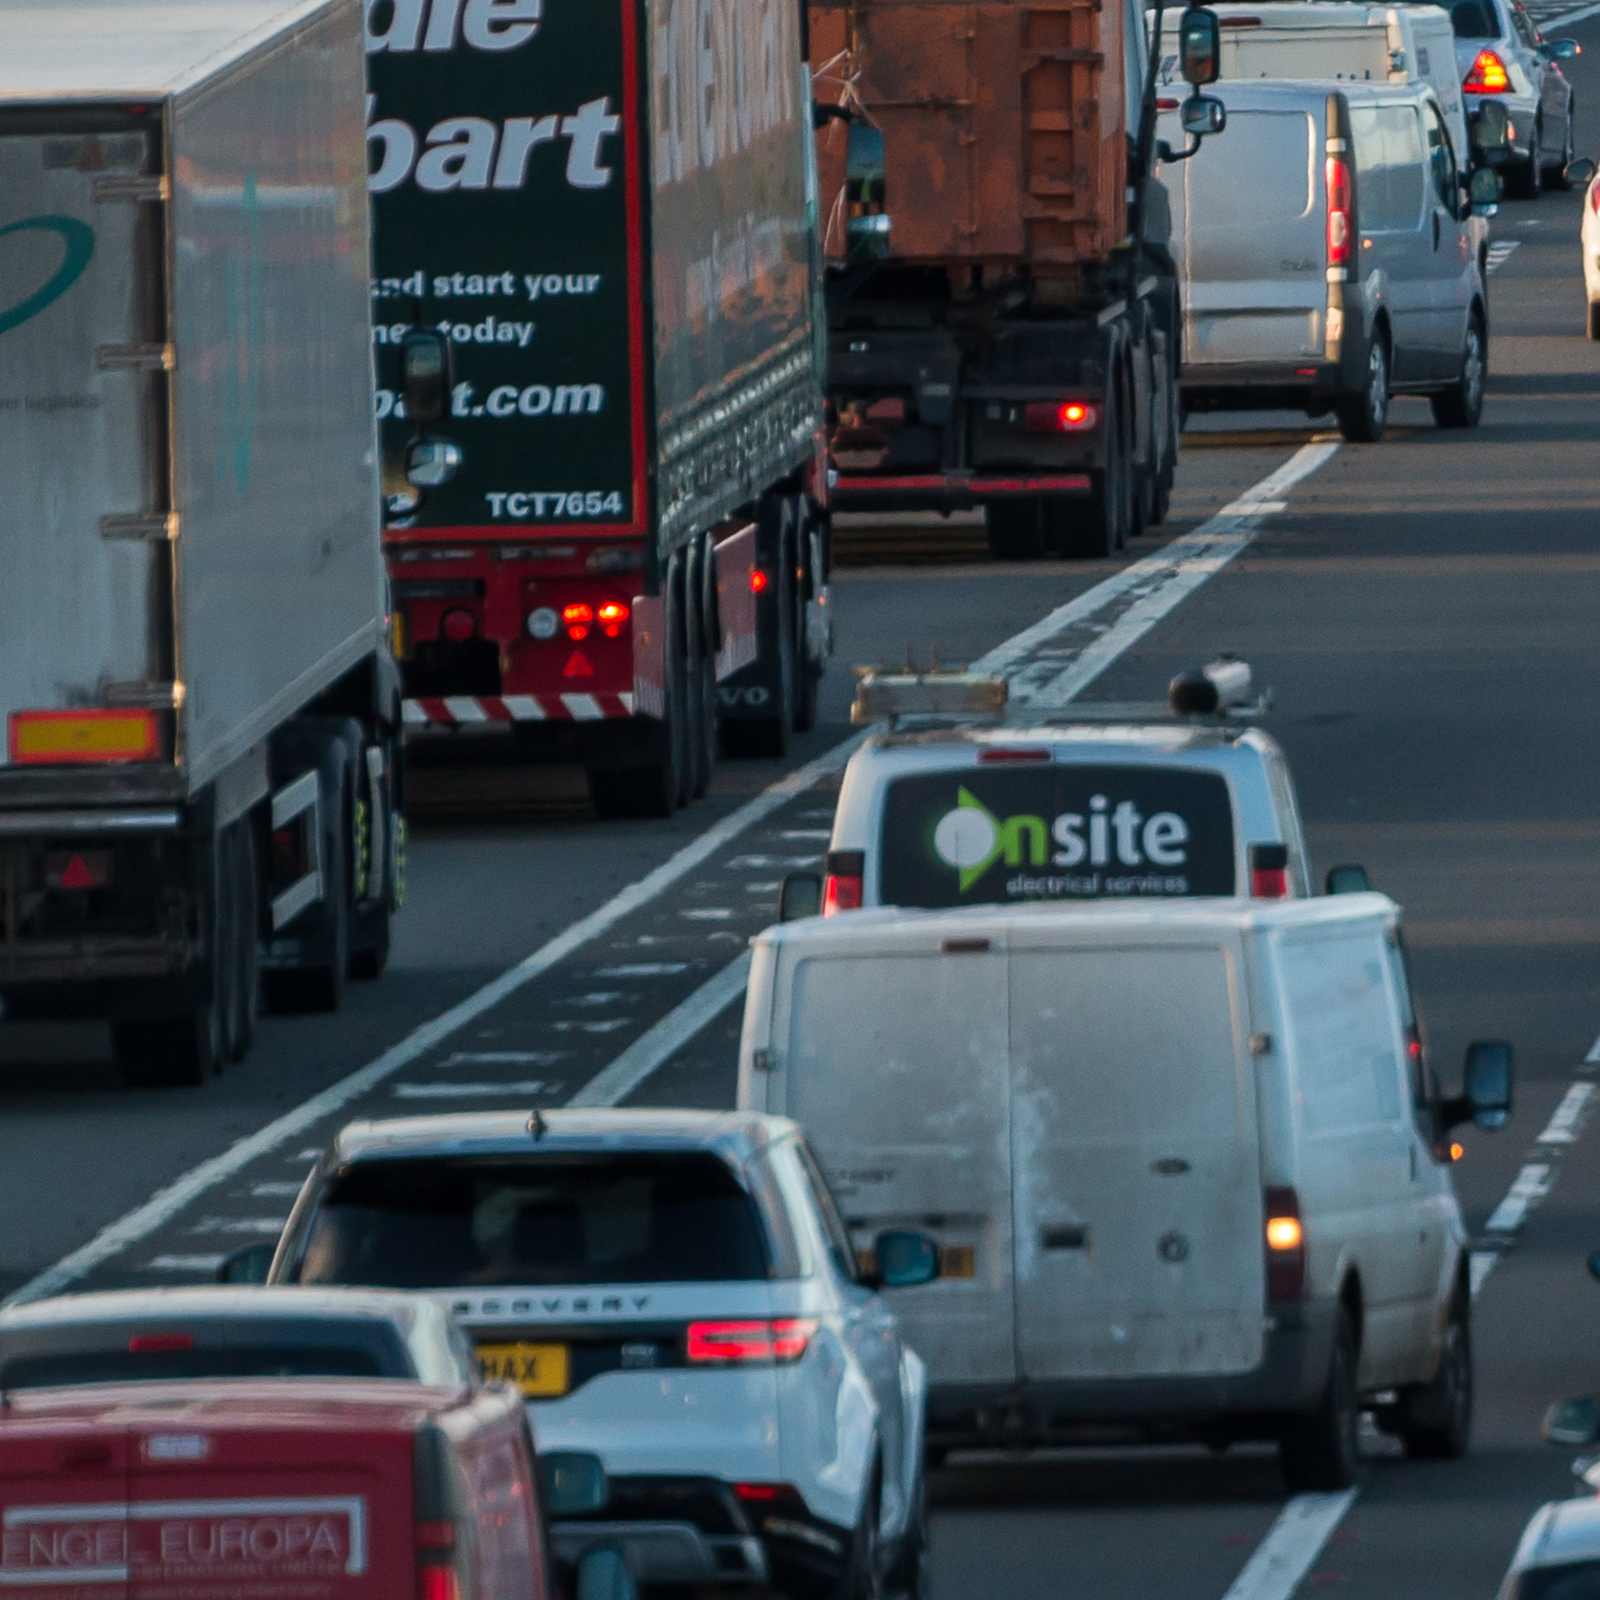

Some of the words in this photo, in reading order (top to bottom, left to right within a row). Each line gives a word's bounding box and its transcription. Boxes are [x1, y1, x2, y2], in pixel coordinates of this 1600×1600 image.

[433, 270, 514, 298] start
[525, 272, 600, 300] your
[485, 491, 623, 518] TCT7654
[1007, 872, 1098, 896] electrical
[1104, 873, 1188, 896] services
[160, 1517, 340, 1564] EUROPA
